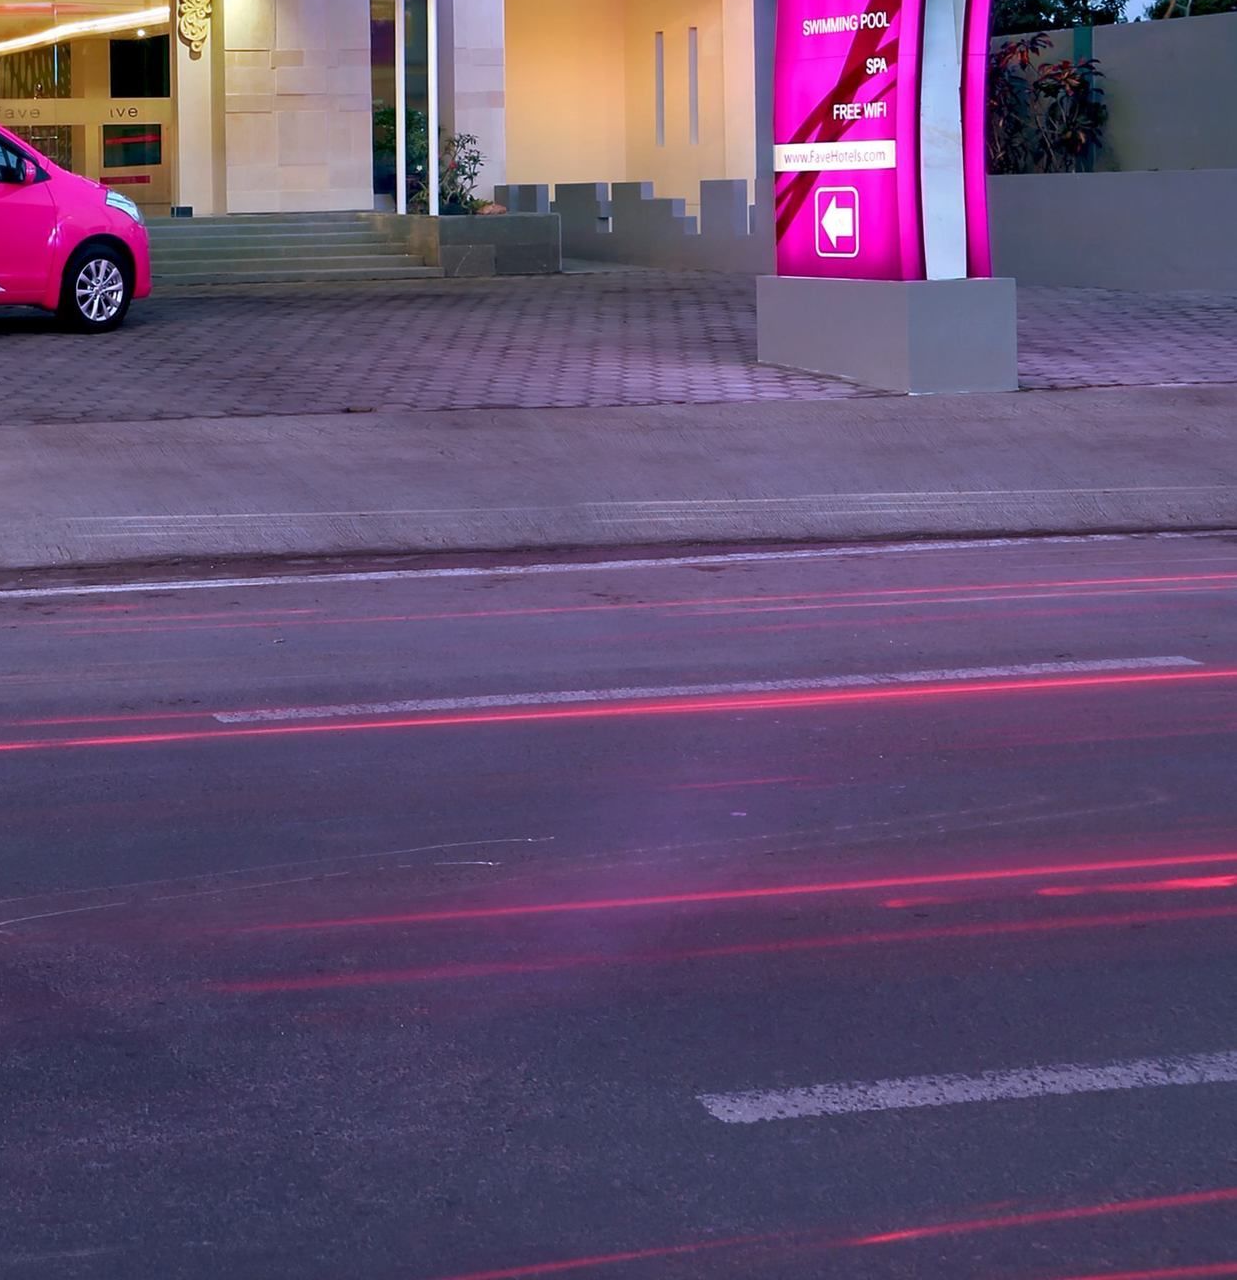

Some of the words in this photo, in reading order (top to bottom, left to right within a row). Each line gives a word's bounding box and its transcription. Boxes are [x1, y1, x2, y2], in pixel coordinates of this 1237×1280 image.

[802, 14, 859, 36] SWIMMING
[860, 11, 890, 29] POOL
[865, 57, 888, 75] SPA
[833, 103, 861, 120] FREE
[863, 101, 887, 119] WIFI
[784, 148, 886, 164] www.FaveHotels.com
